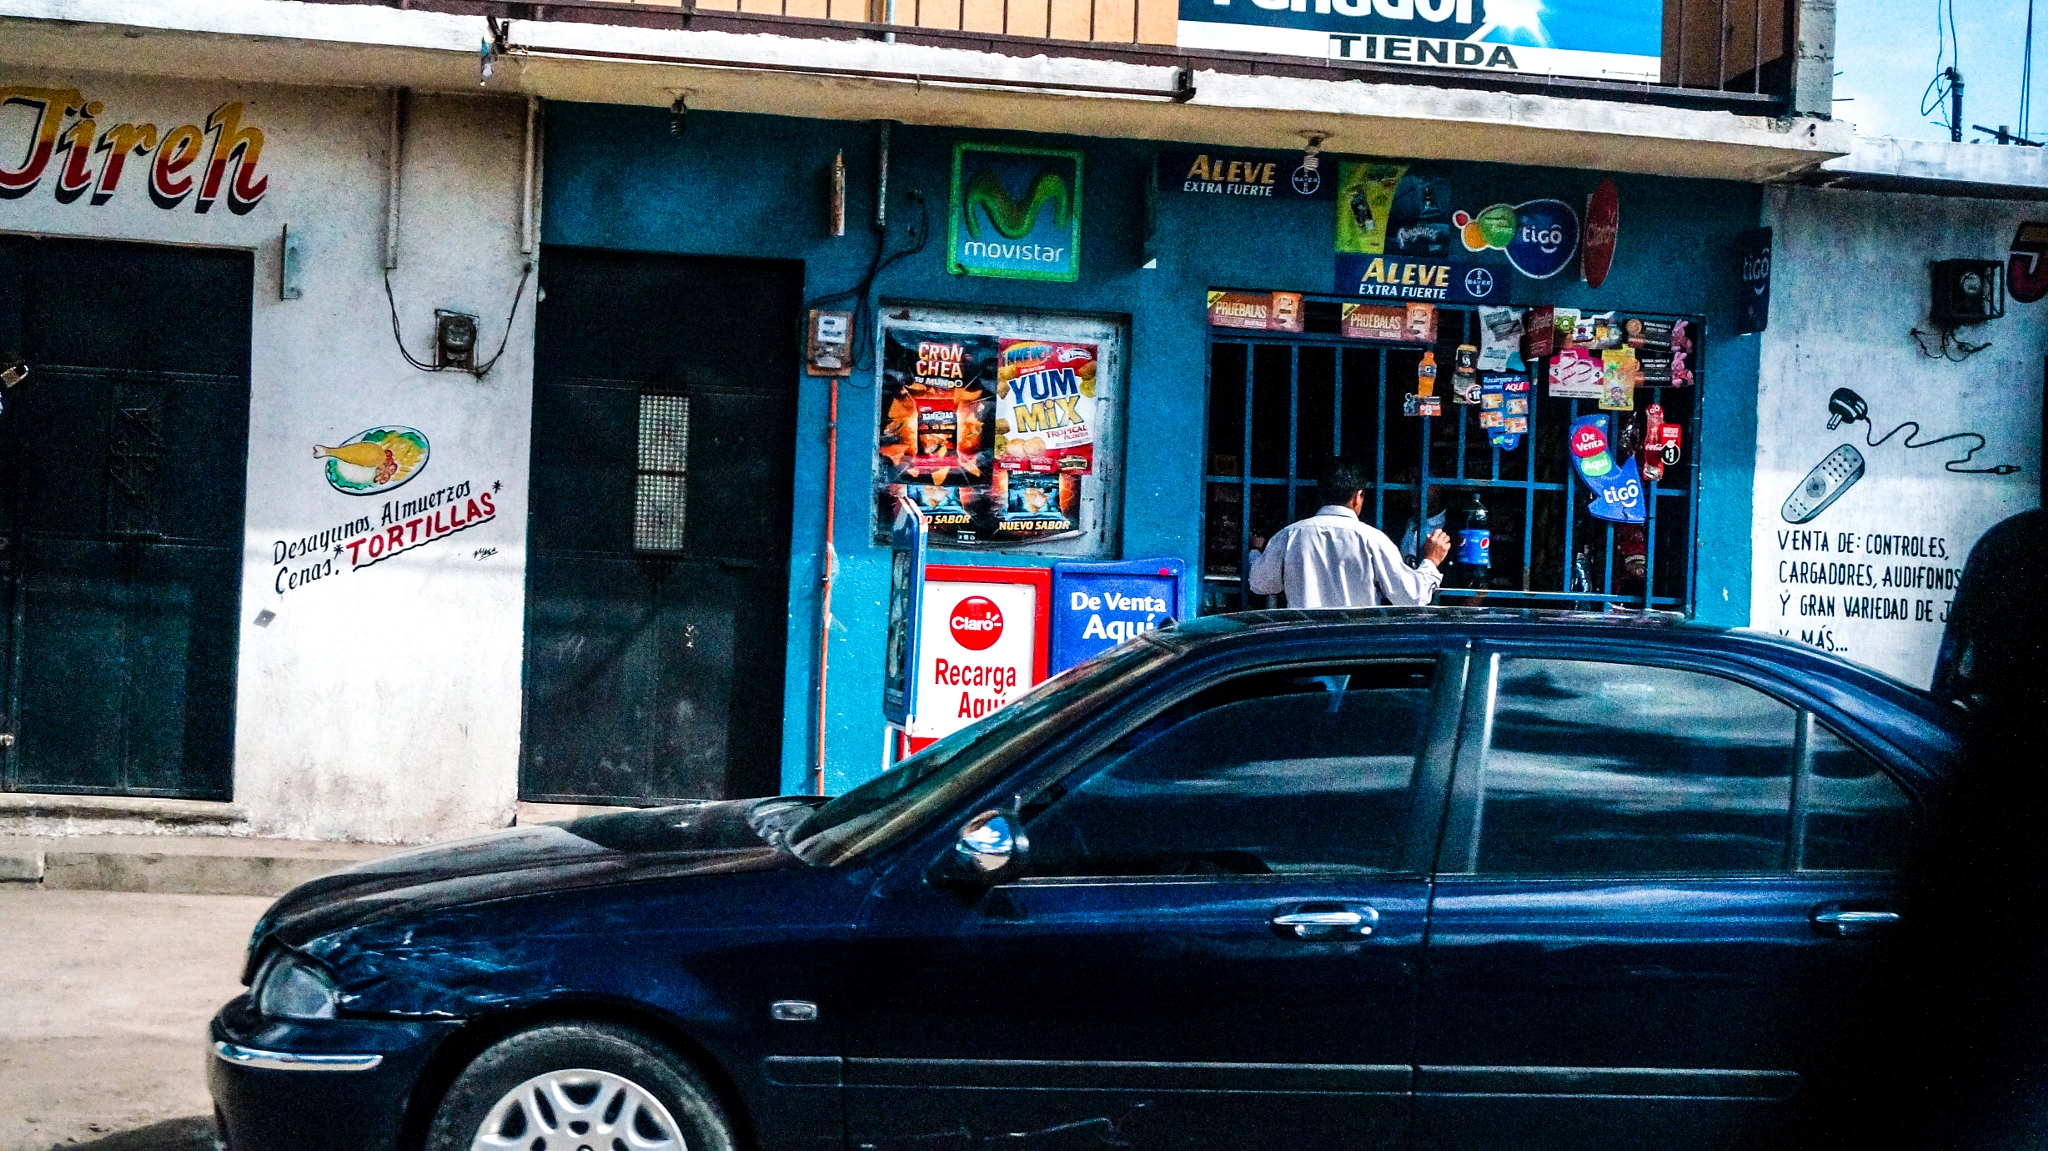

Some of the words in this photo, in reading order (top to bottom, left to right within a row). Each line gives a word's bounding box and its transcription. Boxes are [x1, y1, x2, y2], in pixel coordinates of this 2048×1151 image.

[1329, 34, 1518, 70] TIENDA
[0, 85, 268, 215] Jireh
[1187, 154, 1277, 184] ALEVE
[1183, 181, 1222, 194] EXTRA
[1227, 183, 1274, 196] FUERTE
[1522, 224, 1563, 245] tigo
[964, 241, 1065, 262] movistar
[1361, 257, 1451, 288] ALEVE
[1358, 283, 1397, 297] EXTRA
[1401, 286, 1448, 300] FUERTE
[918, 342, 963, 362] CRON
[916, 360, 963, 379] CHEA
[1009, 367, 1079, 404] YUM
[1046, 424, 1088, 439] TROPICAL
[1581, 432, 1596, 443] De
[1576, 439, 1604, 452] Venta
[1603, 479, 1639, 504] tigo
[381, 480, 471, 527] Almuerzos
[345, 492, 496, 566] TORTILLAS
[934, 513, 971, 524] SABOR
[998, 521, 1033, 531] NUEVO
[1035, 520, 1071, 530] SABOR
[1777, 530, 1829, 552] VENTA
[1838, 532, 1861, 553] DE:
[1866, 534, 1950, 560] CONTROLES,
[1779, 560, 1878, 589] CARGADORES,
[1071, 591, 1101, 611] De
[1103, 592, 1166, 612] Venta
[1779, 594, 1791, 616] Y
[1800, 594, 1835, 617] GRAN
[1843, 596, 1908, 621] VARIEDAD
[1915, 599, 1933, 622] DE
[951, 614, 995, 632] Claro
[1082, 613, 1155, 645] Aquí
[935, 658, 1016, 694] Recarga
